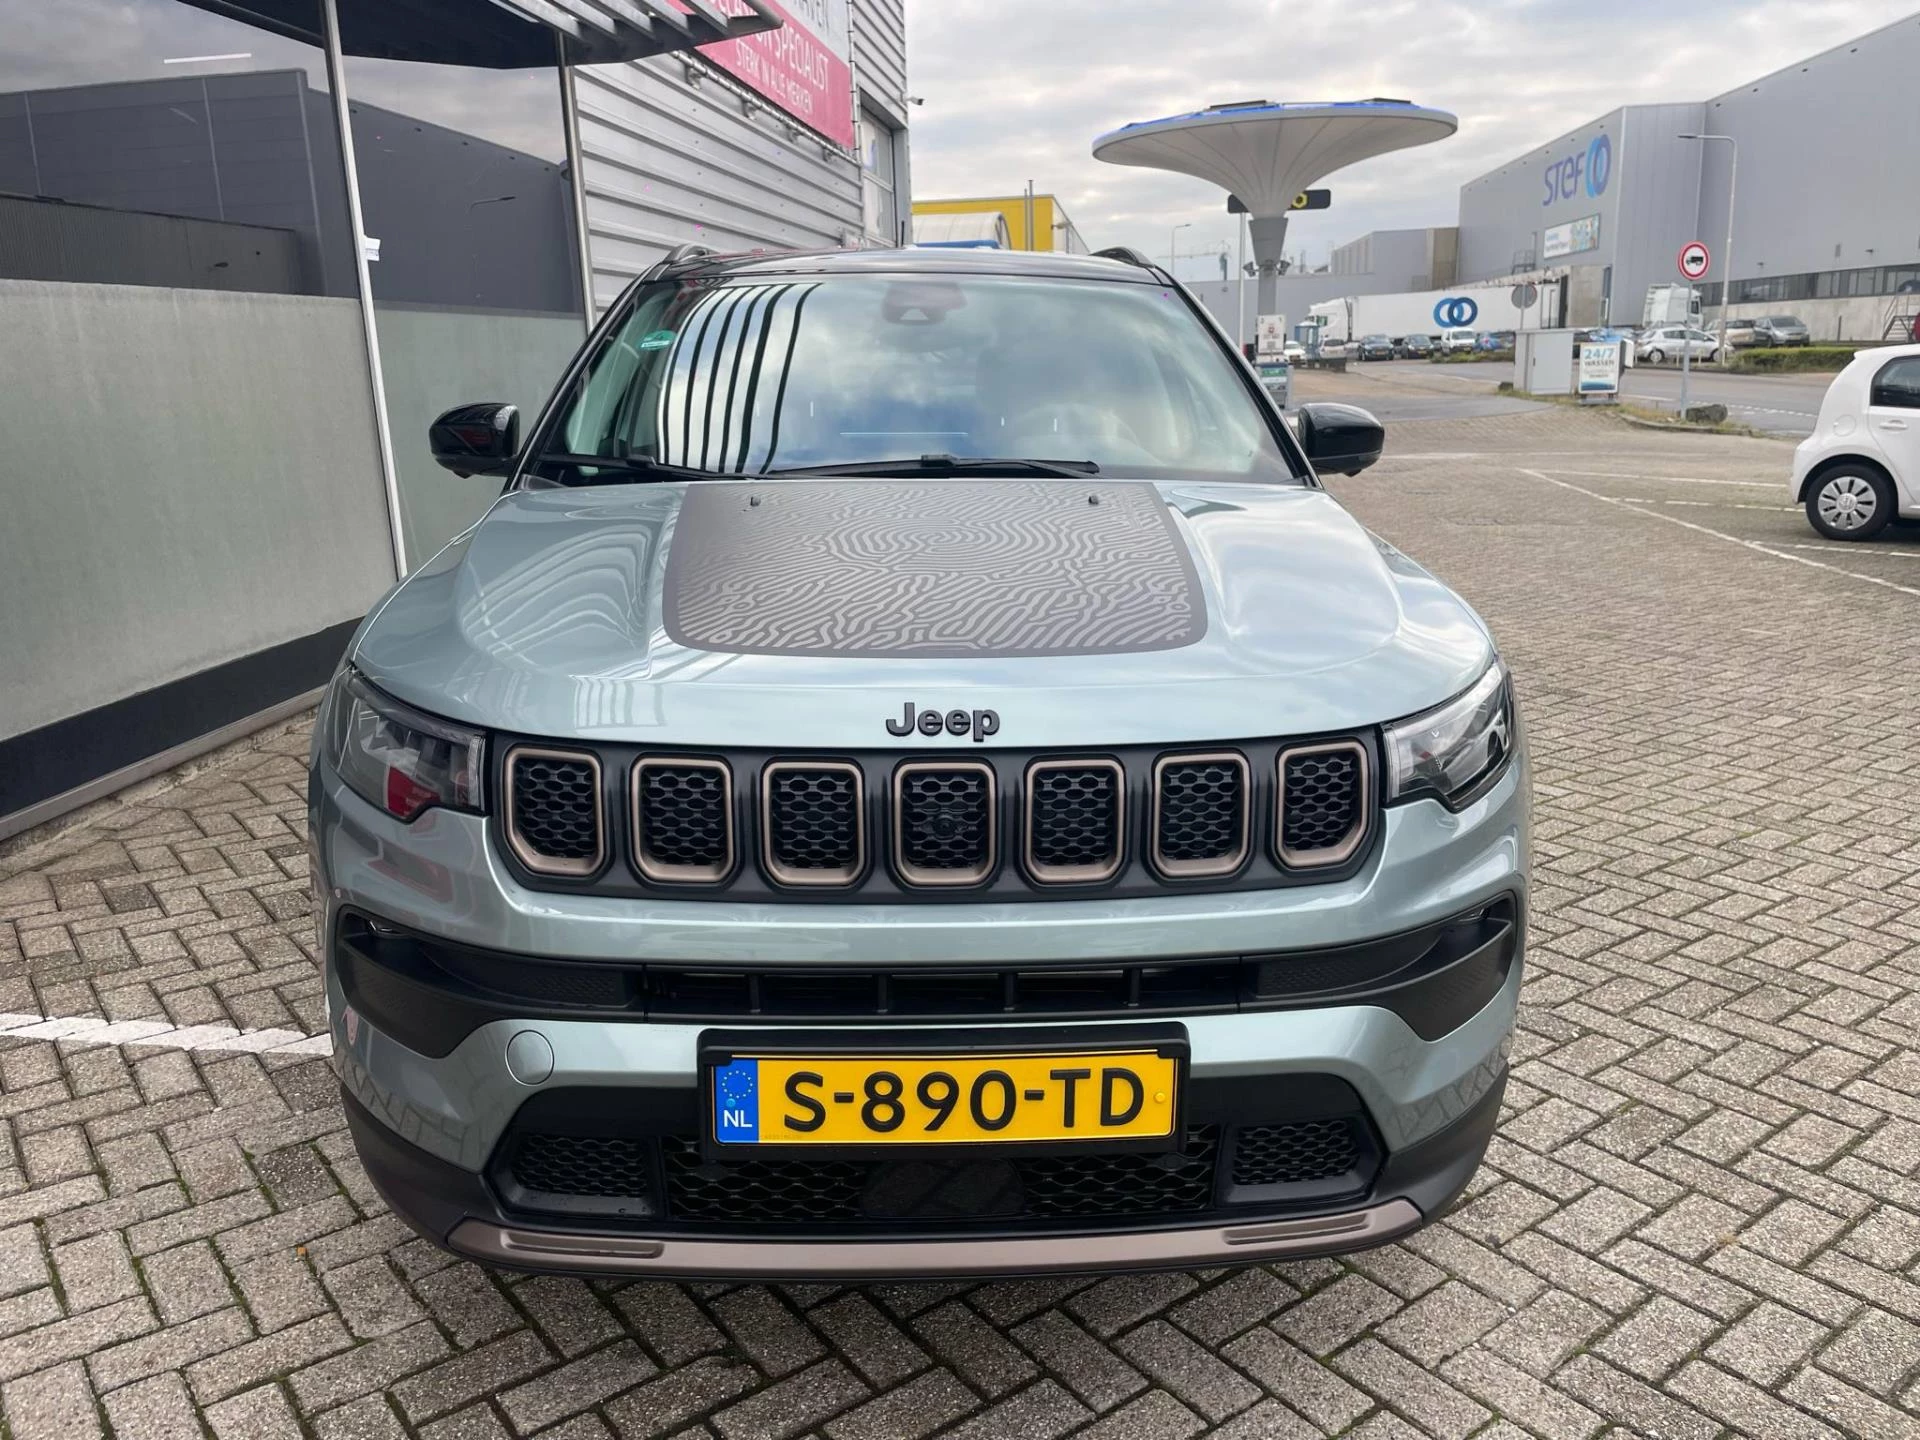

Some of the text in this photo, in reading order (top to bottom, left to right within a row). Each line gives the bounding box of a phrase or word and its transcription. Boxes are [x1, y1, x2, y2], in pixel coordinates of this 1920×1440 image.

[773, 22, 829, 94] SPECIALIST
[1584, 347, 1616, 360] 24/7
[886, 702, 1000, 742] Jeep
[722, 1068, 1145, 1132] NL S-890-TD
